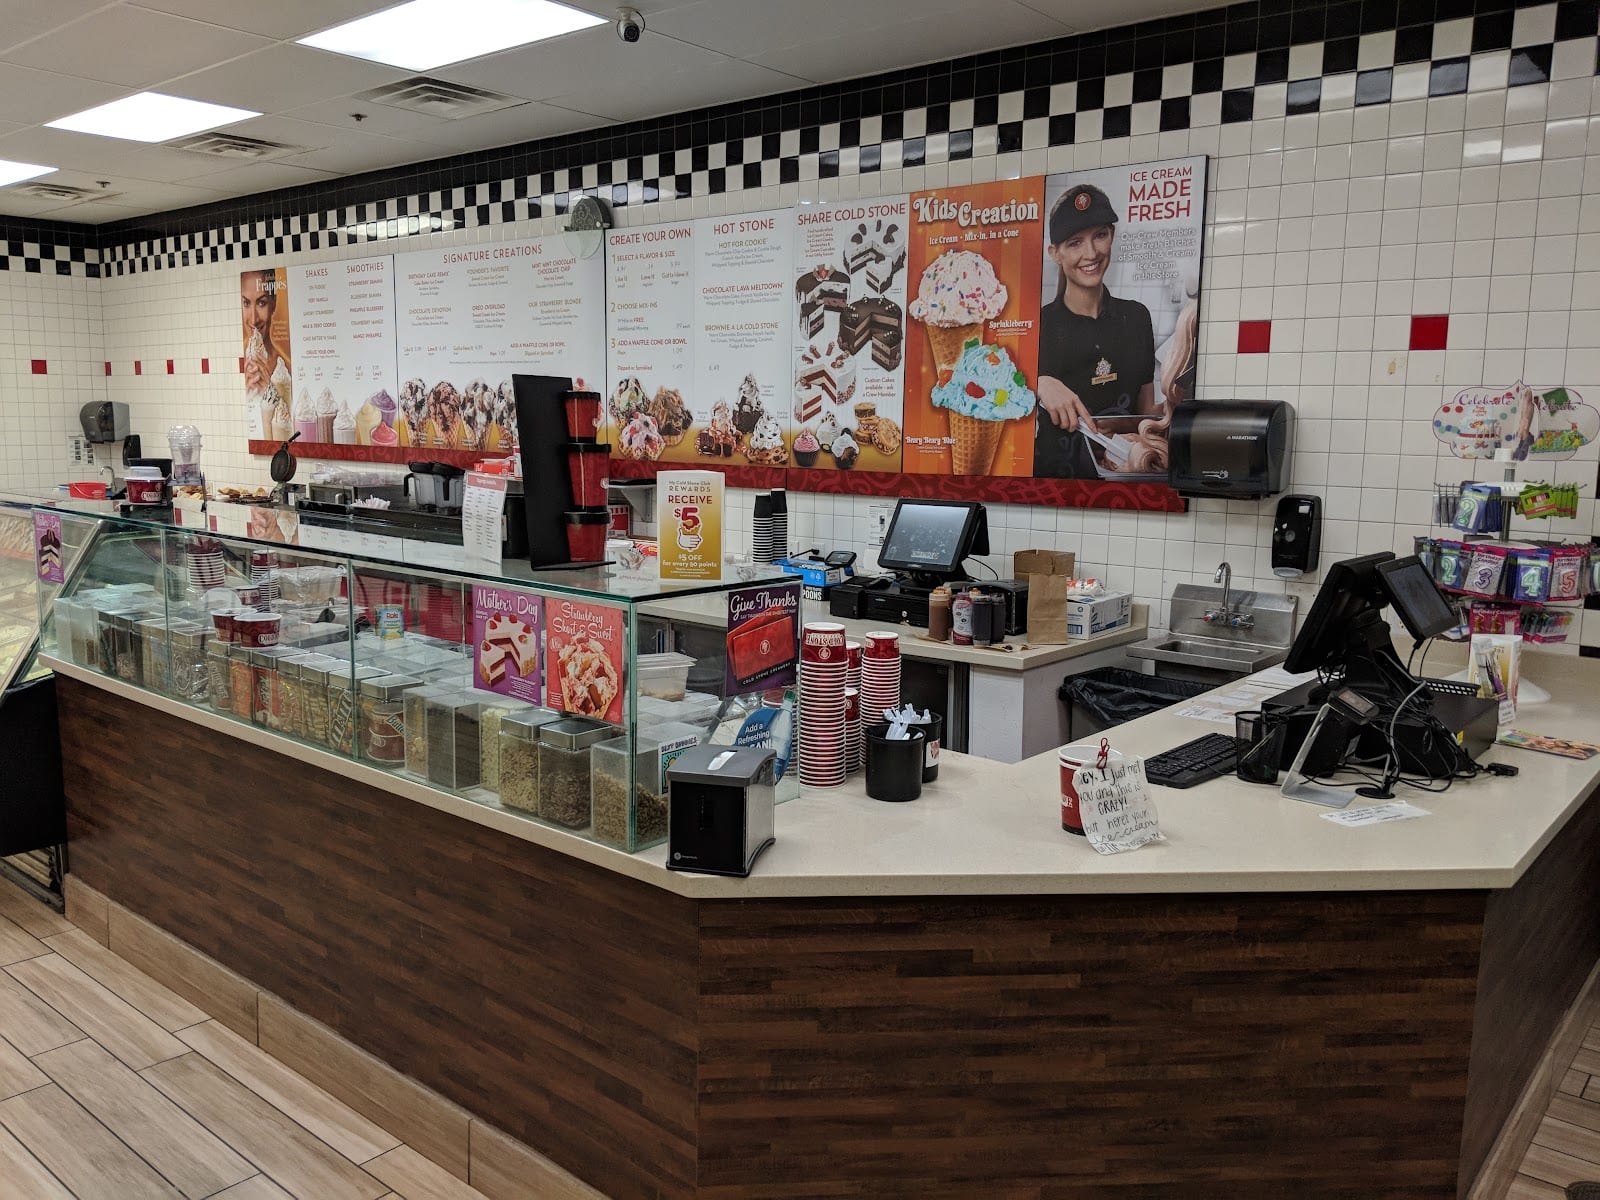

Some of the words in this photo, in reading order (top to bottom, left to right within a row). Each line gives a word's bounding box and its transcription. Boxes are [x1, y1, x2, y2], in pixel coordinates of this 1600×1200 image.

[1130, 172, 1148, 182] ICE
[1152, 166, 1192, 180] CREAM
[1129, 179, 1191, 202] MADE
[798, 212, 832, 226] SHARE
[834, 208, 865, 221] COLD
[868, 203, 906, 218] STONE
[913, 197, 958, 222] Kids
[958, 198, 1039, 227] Creation
[1128, 200, 1190, 222] FRESH
[610, 234, 640, 246] CREATE
[642, 230, 666, 242] YOUR
[669, 228, 691, 240] OWN
[714, 223, 736, 235] HOT
[740, 219, 774, 232] STONE
[929, 237, 938, 245] Ice
[939, 235, 958, 244] Cream
[444, 250, 490, 264] SIGNATURE
[493, 244, 542, 258] CREATIONS
[306, 268, 328, 278] SHAKES
[346, 262, 384, 274] SMOOTHIES
[256, 276, 286, 296] Frappés
[702, 286, 735, 294] CHOCOLATE
[750, 282, 782, 290] MELTDOWN
[610, 302, 616, 312] 2
[610, 338, 616, 348] 3
[1458, 394, 1515, 406] Celebrate
[668, 495, 712, 504] RECEIVE
[674, 507, 700, 530] $5
[1474, 568, 1492, 590] 3
[1521, 566, 1542, 597] 4
[1560, 570, 1577, 594] 5
[476, 589, 512, 612] Mother's
[518, 596, 538, 624] Day
[561, 602, 603, 628] Strawberry
[730, 595, 756, 620] Give
[756, 591, 797, 610] Thanks
[552, 617, 577, 634] Short
[588, 623, 614, 642] Sweet
[743, 676, 754, 684] COLD
[756, 672, 768, 681] STONE
[738, 731, 770, 744] Refreshing
[745, 724, 758, 734] Add
[1110, 766, 1126, 786] just
[1096, 785, 1114, 800] and
[1098, 796, 1128, 816] CRAZY!
